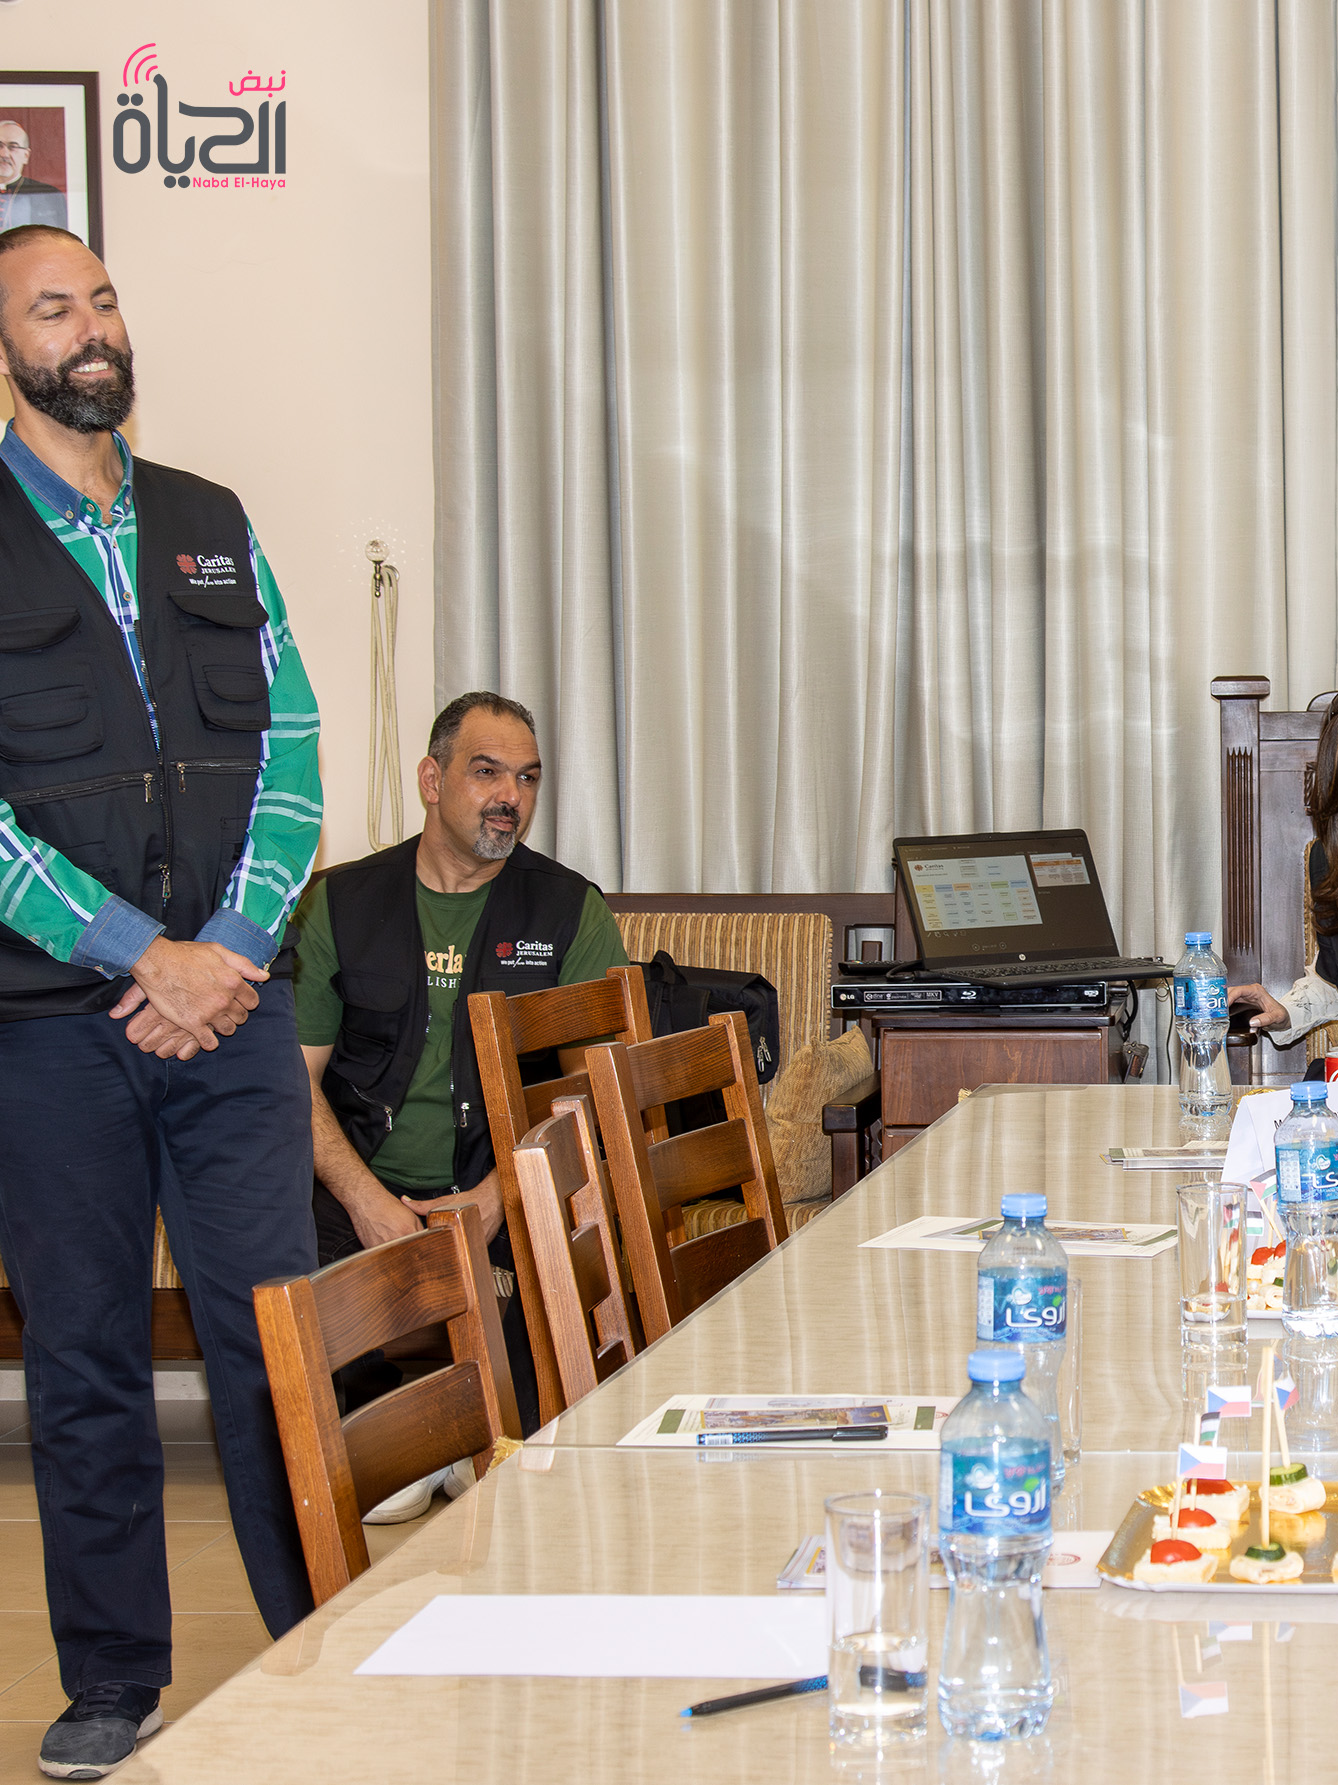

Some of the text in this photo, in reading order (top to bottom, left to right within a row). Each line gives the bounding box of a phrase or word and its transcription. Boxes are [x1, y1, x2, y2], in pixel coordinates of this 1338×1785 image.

[197, 554, 235, 567] Caritas
[516, 940, 553, 951] Caritas
[424, 945, 467, 974] erla
[427, 976, 461, 989] LISH
[1206, 996, 1228, 1009] ar
